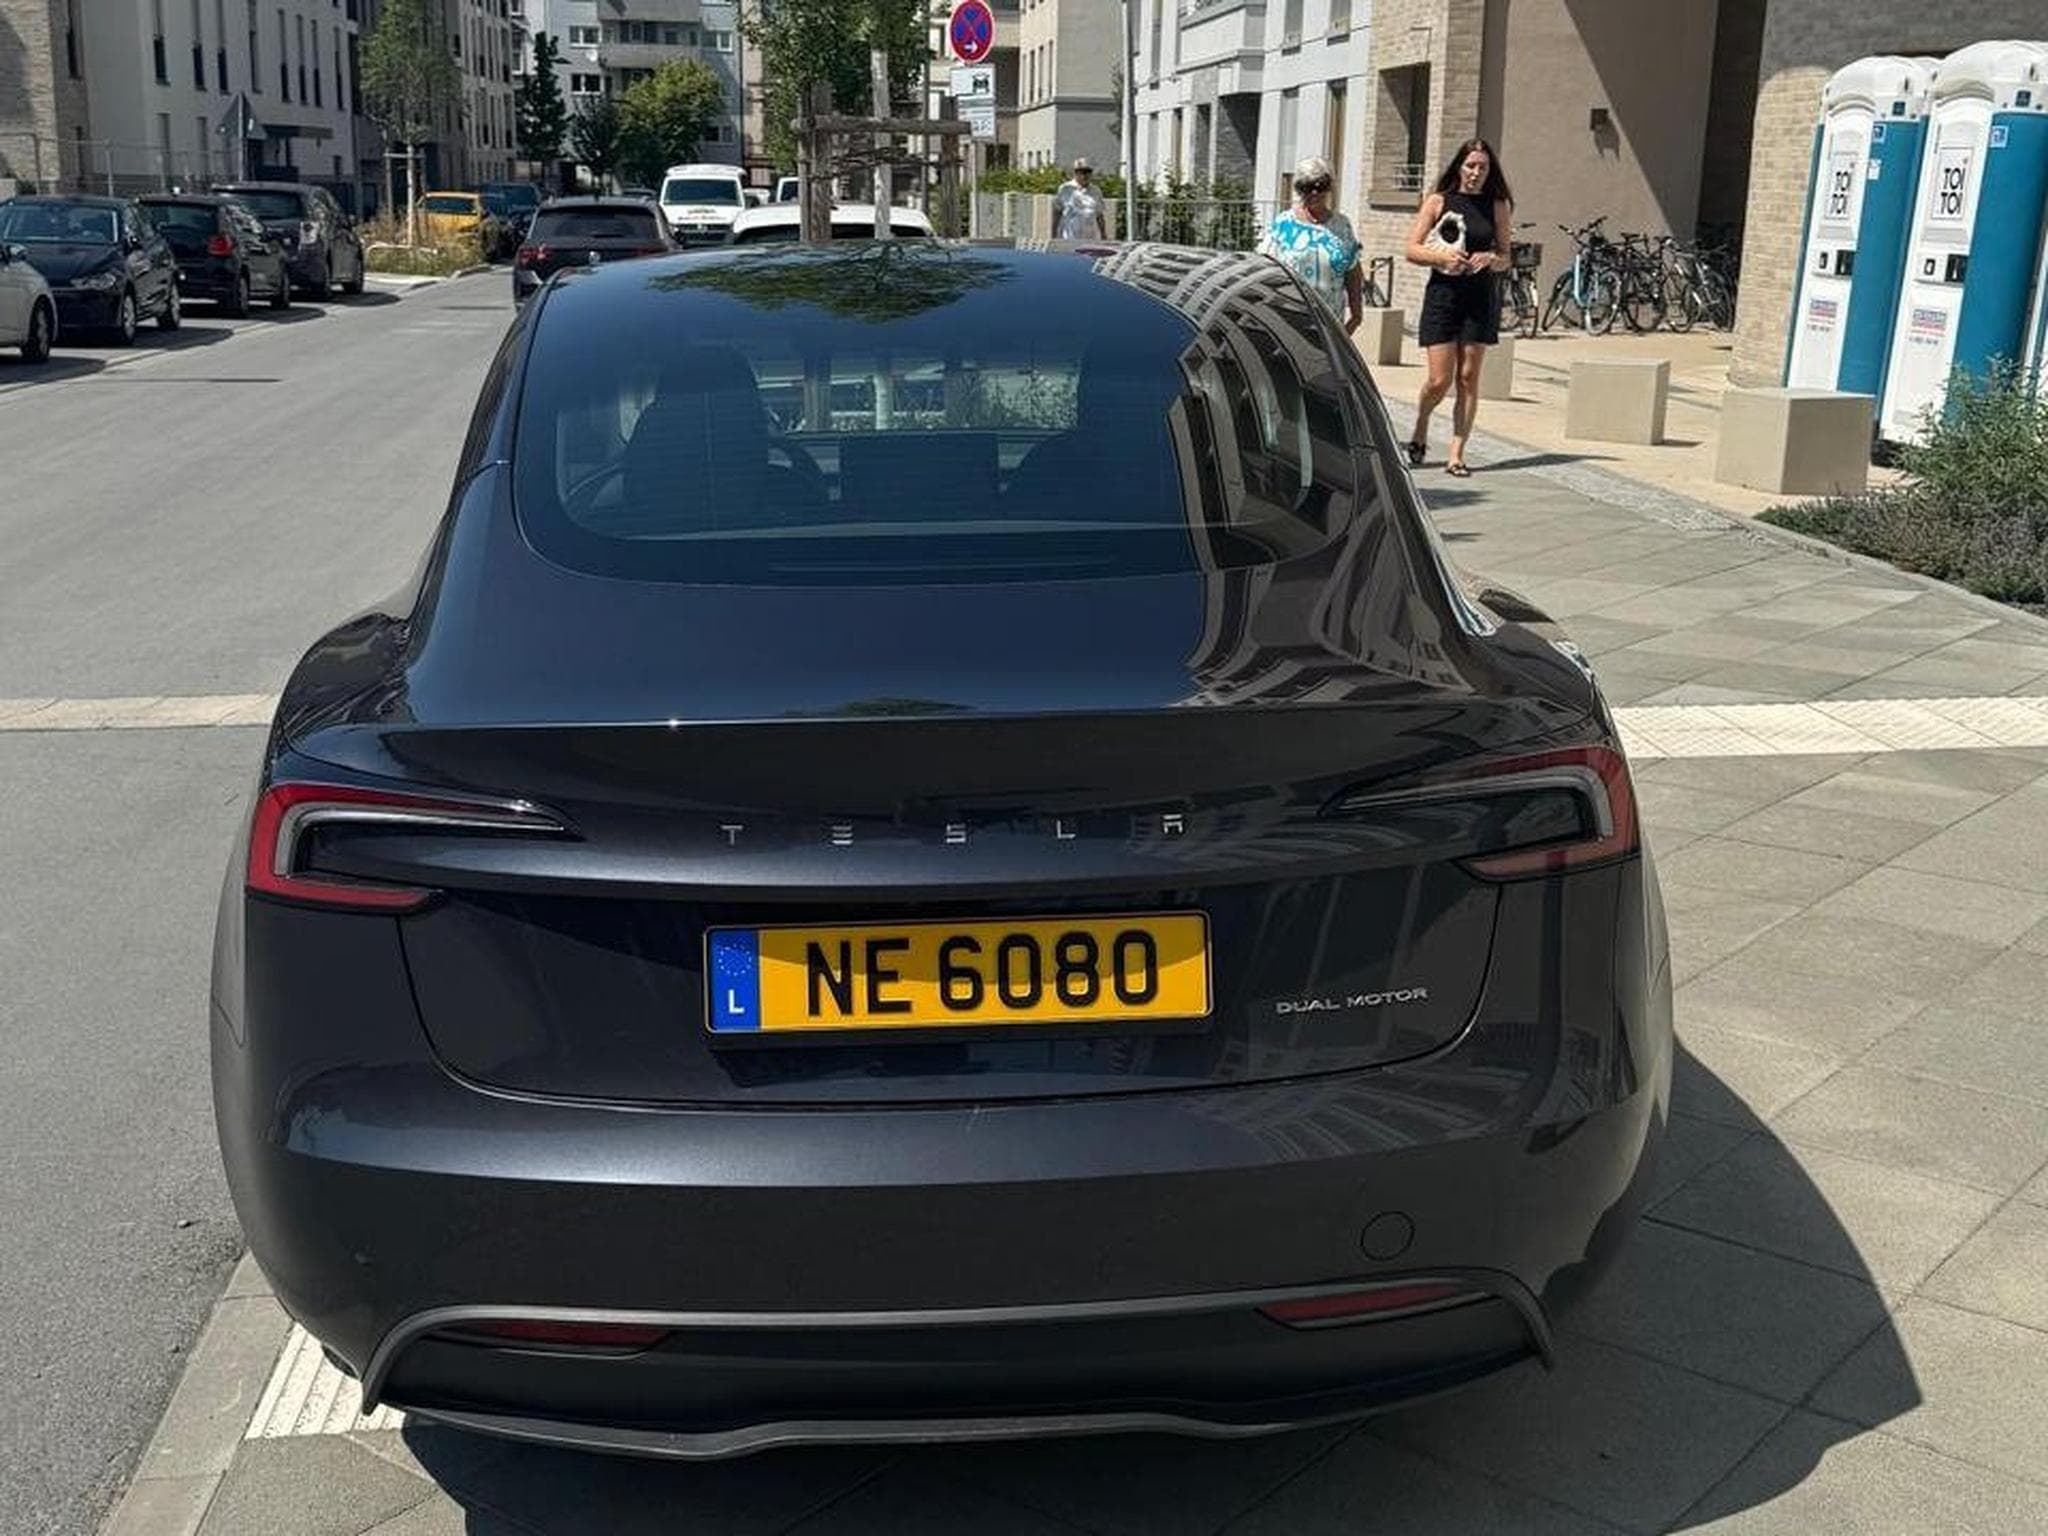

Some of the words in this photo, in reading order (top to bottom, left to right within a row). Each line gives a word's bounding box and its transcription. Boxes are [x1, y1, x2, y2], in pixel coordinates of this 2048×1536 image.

[1835, 170, 1851, 192] TOI
[1944, 167, 1966, 190] TOI
[1829, 192, 1848, 214] TOI
[1940, 191, 1963, 214] TOI
[721, 813, 1184, 845] TESLA
[806, 938, 913, 1017] NE
[938, 930, 1158, 1011] 6080
[728, 989, 745, 1014] L
[1276, 998, 1340, 1014] DUAL
[1347, 987, 1428, 1008] MOTOR
